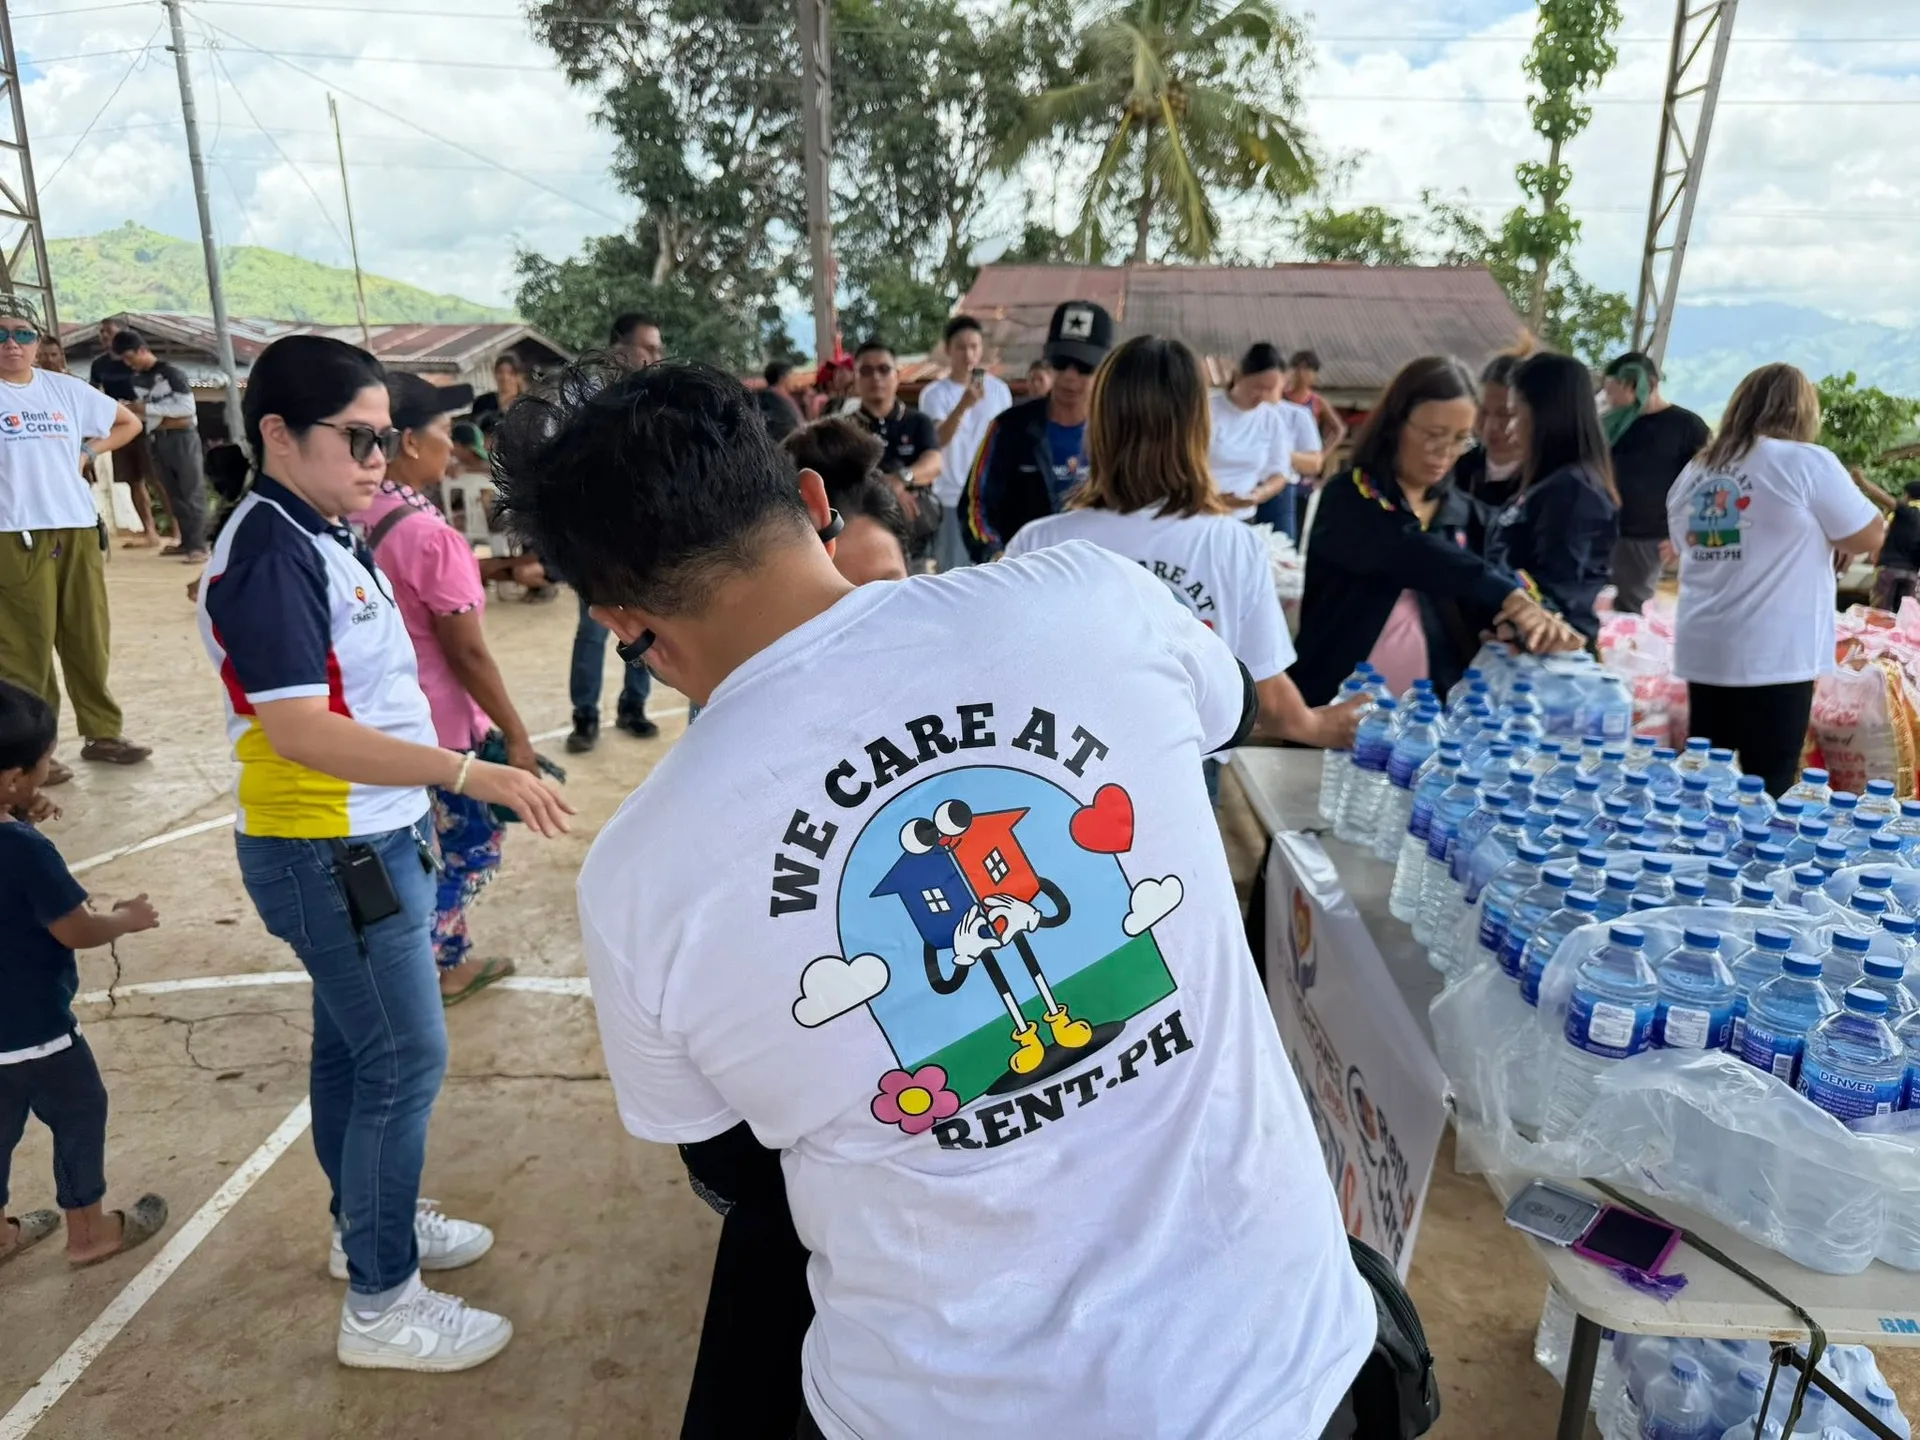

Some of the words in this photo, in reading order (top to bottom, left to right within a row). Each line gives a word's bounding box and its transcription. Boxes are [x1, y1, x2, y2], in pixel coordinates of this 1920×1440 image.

[26, 422, 69, 433] Cares
[1184, 580, 1215, 613] AT
[769, 808, 839, 918] WE
[825, 702, 997, 809] CARE
[1010, 706, 1110, 778] AT
[931, 1008, 1195, 1151] RENT.PH
[1819, 1069, 1876, 1094] DENVER
